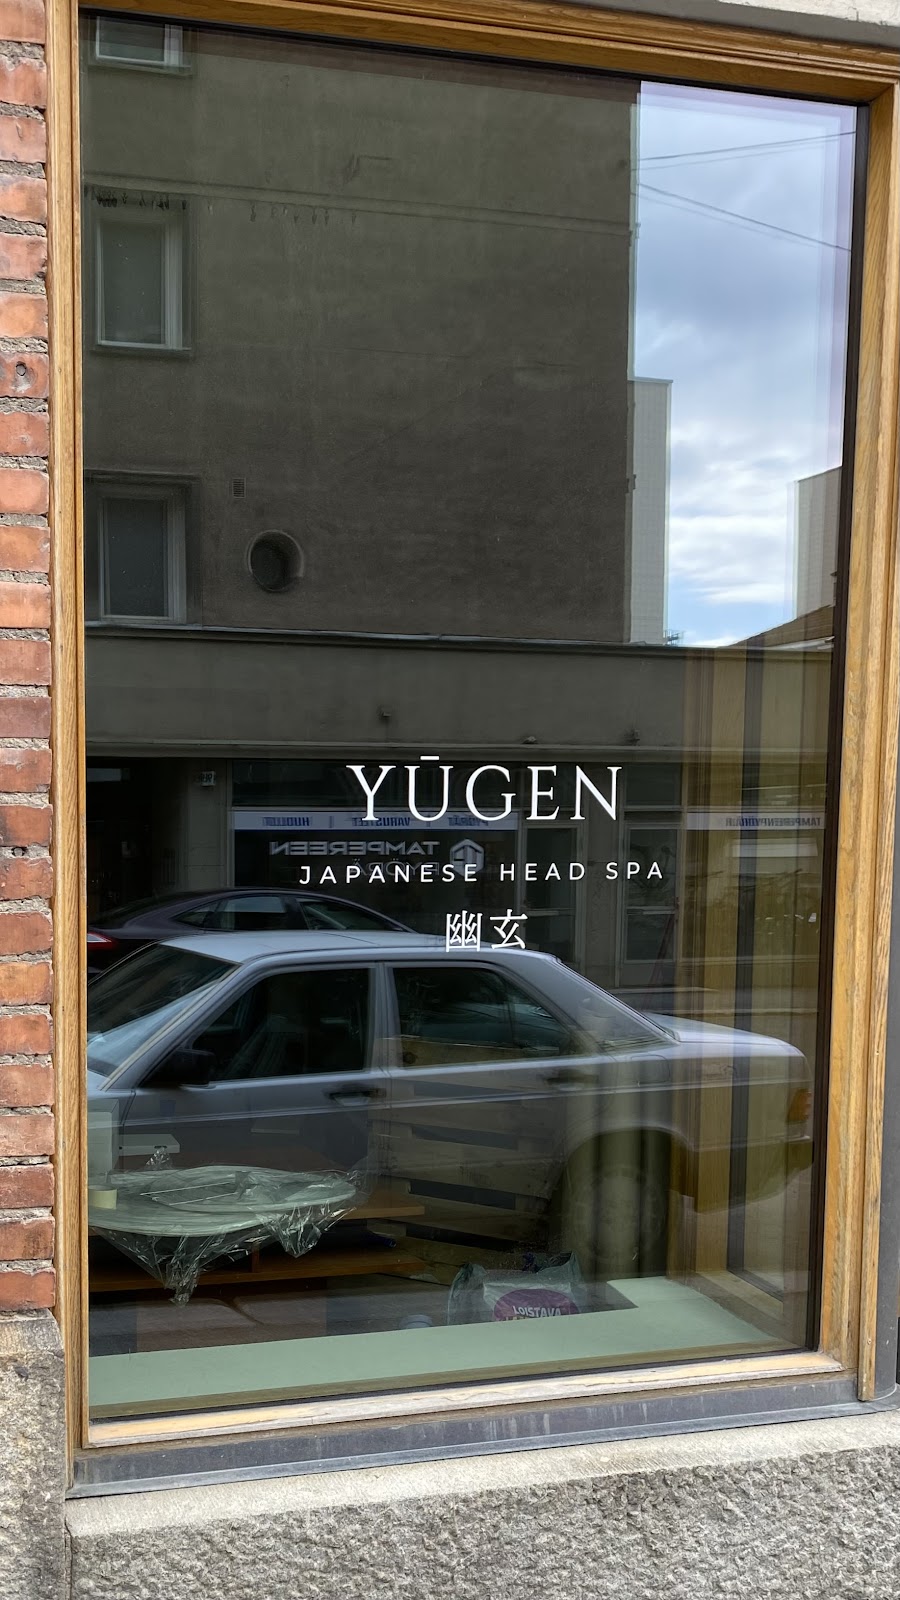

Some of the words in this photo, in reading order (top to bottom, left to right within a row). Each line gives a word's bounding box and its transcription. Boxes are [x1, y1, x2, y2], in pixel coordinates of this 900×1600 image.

[346, 755, 622, 822] YŪGEN
[299, 863, 477, 885] JAPANESE
[500, 863, 585, 882] HEAD
[605, 861, 663, 881] SPA
[445, 908, 528, 954] 幽玄
[512, 1305, 562, 1318] LOISTAVA
